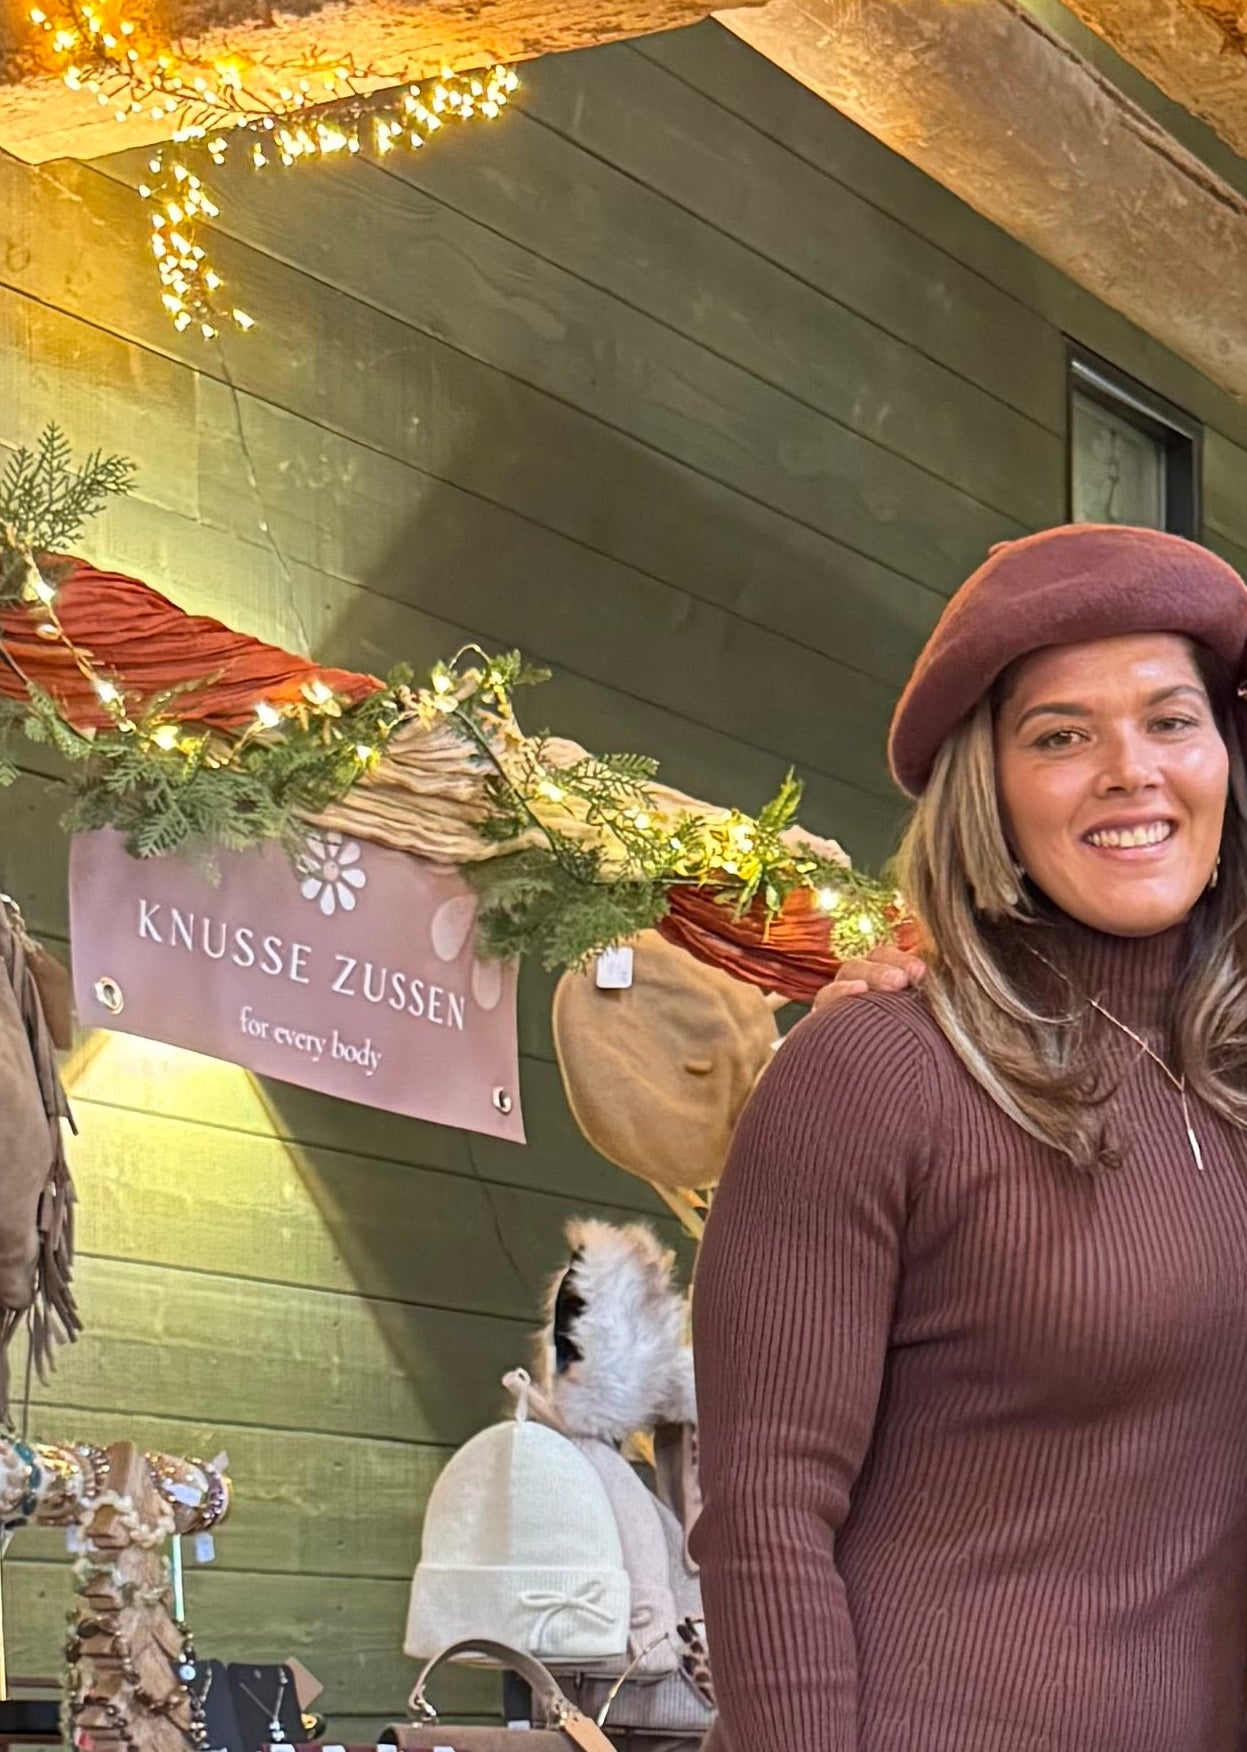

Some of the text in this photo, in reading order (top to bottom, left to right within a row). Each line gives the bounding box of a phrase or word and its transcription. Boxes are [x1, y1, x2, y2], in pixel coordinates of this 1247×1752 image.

[138, 899, 465, 1030] KNUSSE ZUSSEN
[240, 1005, 382, 1076] for every body
